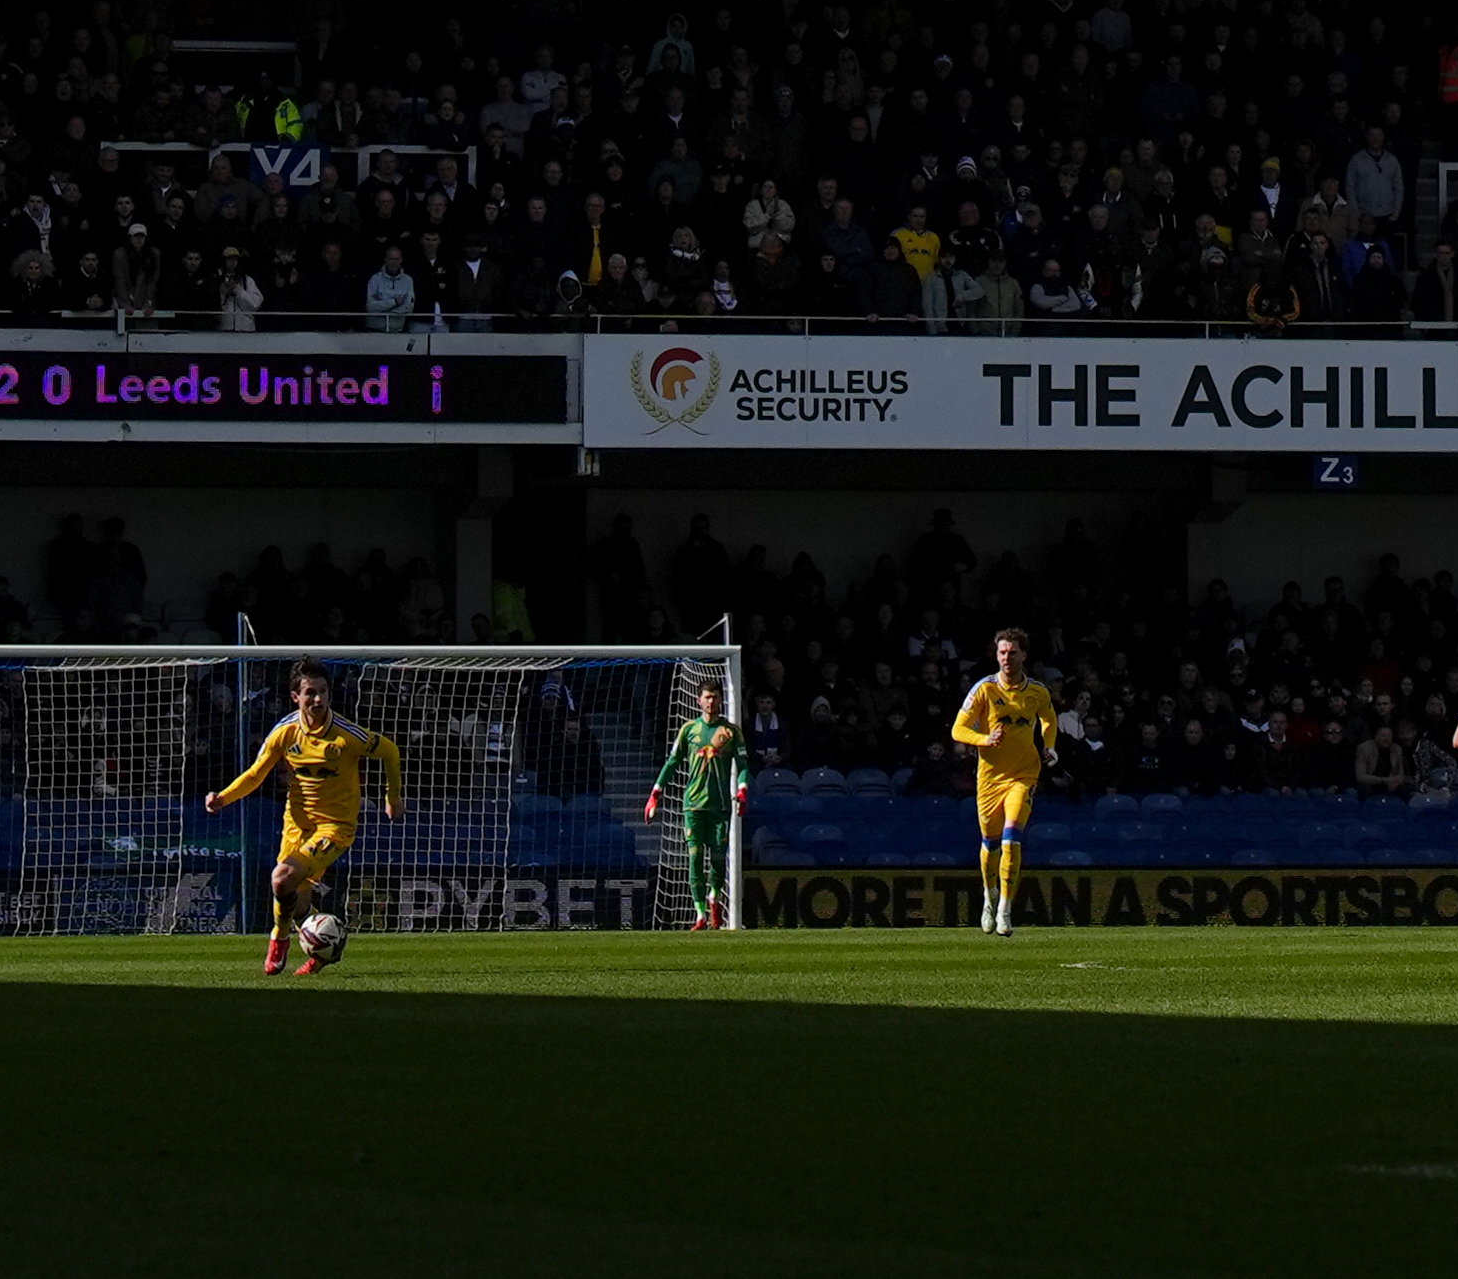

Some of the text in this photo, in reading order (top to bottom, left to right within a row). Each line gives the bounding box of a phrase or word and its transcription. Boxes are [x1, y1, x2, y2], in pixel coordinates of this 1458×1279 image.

[251, 148, 321, 186] Y4
[42, 364, 72, 406] 0
[96, 363, 223, 404] Leeds
[239, 365, 390, 406] United
[729, 369, 910, 395] ACHILLEUS
[982, 363, 1142, 427] THE
[736, 394, 897, 422] SECURITY
[1319, 457, 1355, 484] Z3
[743, 875, 926, 928] MORE
[1103, 876, 1143, 927] A
